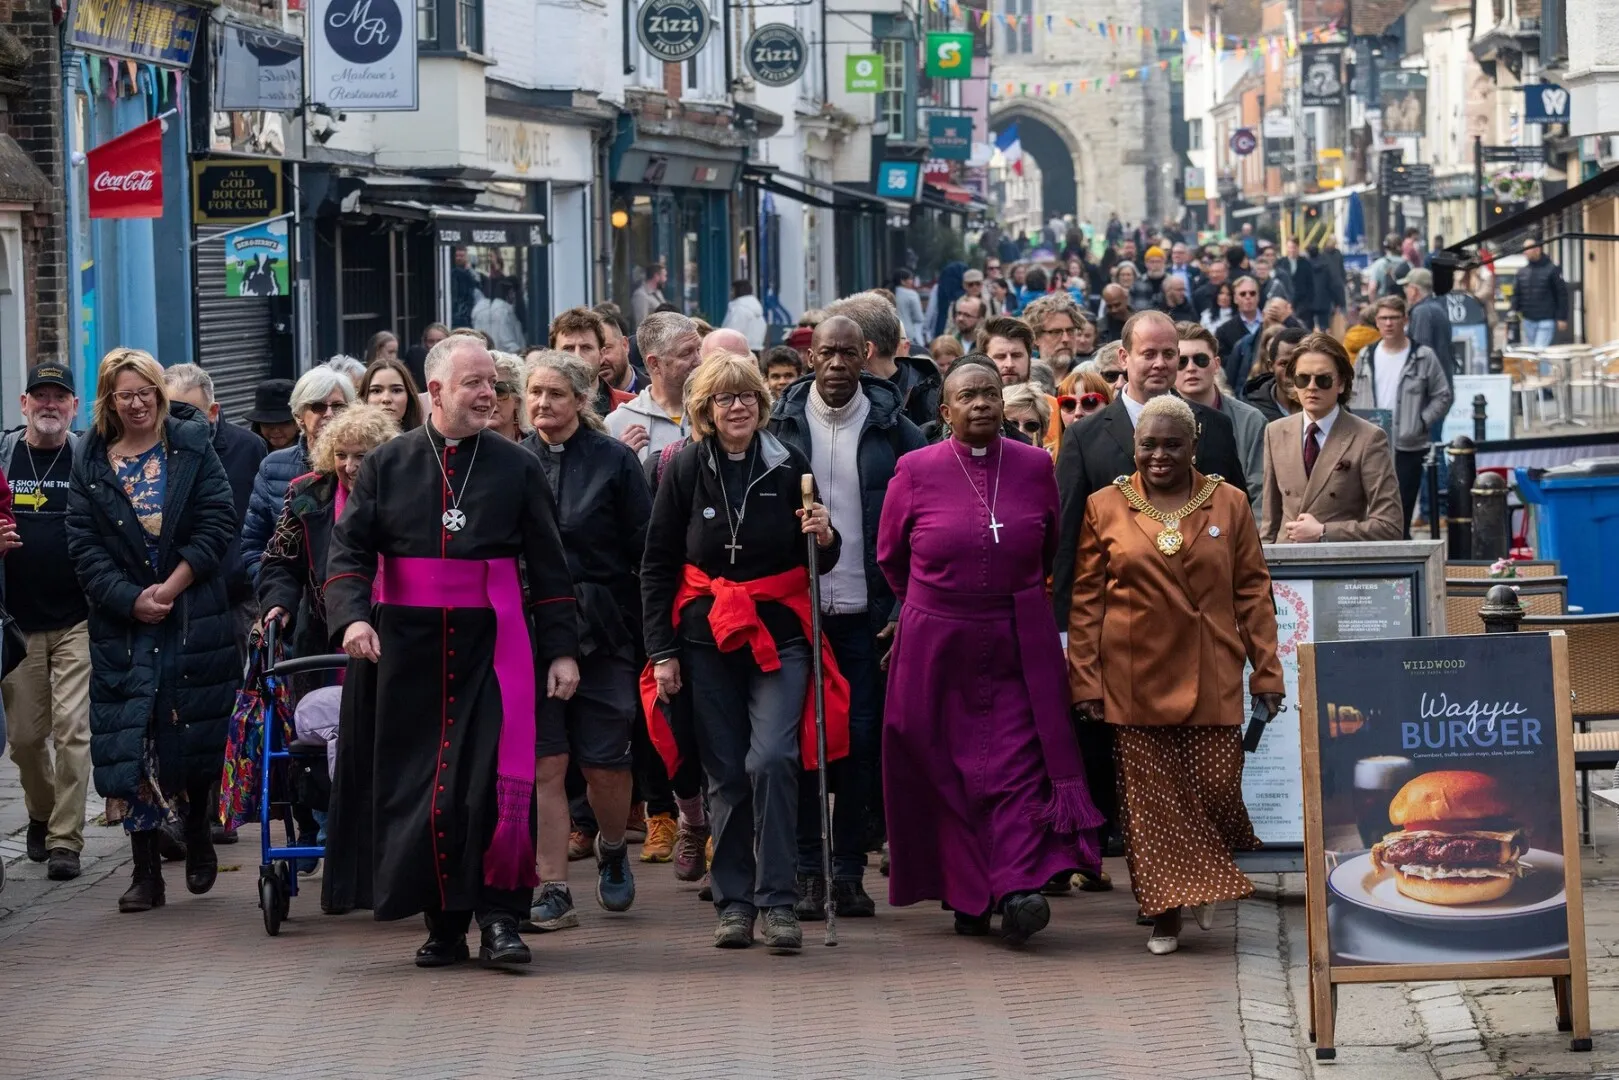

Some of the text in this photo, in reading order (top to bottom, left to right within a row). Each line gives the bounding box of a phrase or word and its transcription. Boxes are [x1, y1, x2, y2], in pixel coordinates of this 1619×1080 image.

[648, 16, 699, 33] Zizzi
[653, 39, 695, 54] ITALIAN
[754, 46, 799, 63] Zizzi
[331, 67, 396, 82] Marlowe's
[328, 86, 398, 100] Restaurant
[93, 170, 157, 192] Coca-Cola
[228, 170, 247, 178] ALL
[220, 179, 255, 188] GOLD
[211, 189, 264, 199] BOUGHT
[208, 200, 268, 210] FOR CASH
[16, 480, 40, 488] SHOW
[1403, 659, 1466, 670] WILDWOOD
[1421, 692, 1528, 735] Wagyu
[1401, 718, 1543, 749] BURGER
